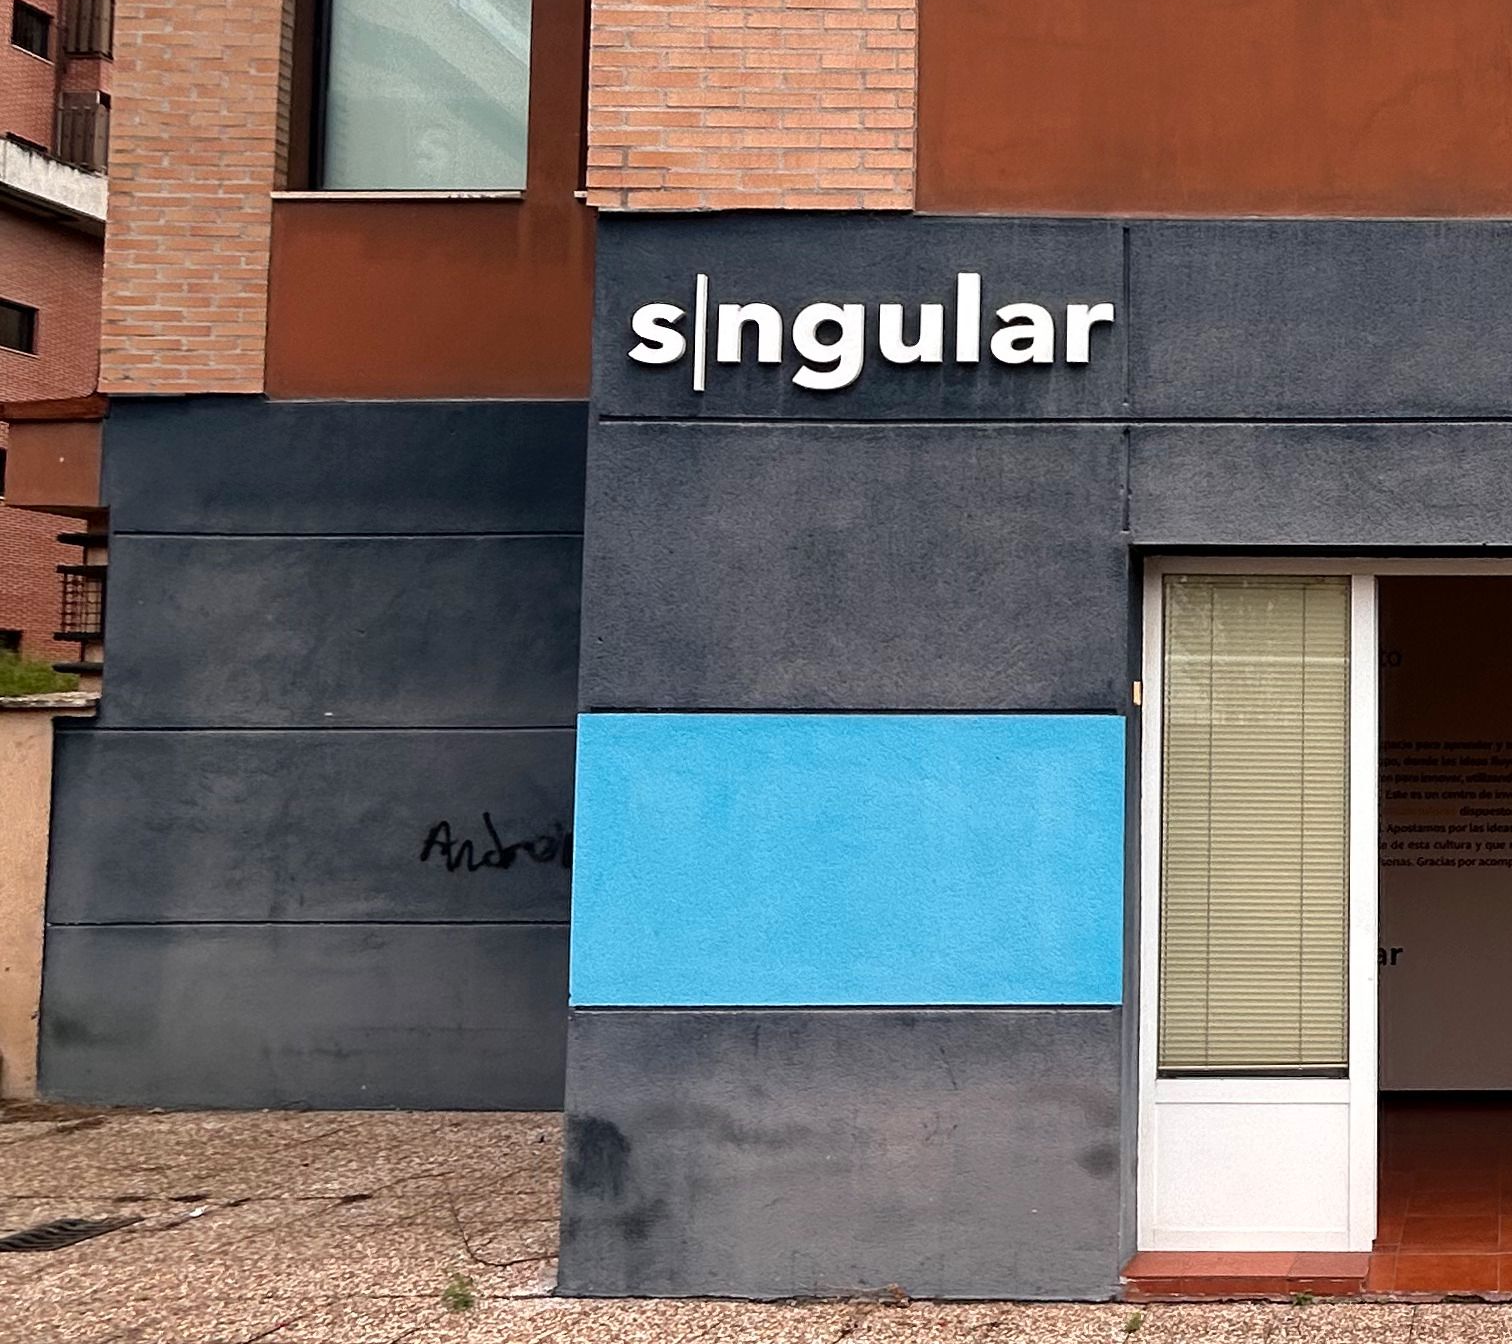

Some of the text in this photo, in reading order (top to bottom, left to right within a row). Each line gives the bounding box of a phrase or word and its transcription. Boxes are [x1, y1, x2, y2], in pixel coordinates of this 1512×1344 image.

[1441, 791, 1477, 799] centro
[1478, 789, 1493, 799] de
[1387, 824, 1446, 834] Apostamos
[1448, 826, 1468, 834] por
[1469, 823, 1484, 833] las
[1390, 840, 1404, 849] de
[1407, 841, 1430, 849] esta
[1433, 840, 1472, 849] cultura
[1474, 842, 1482, 851] y
[1485, 842, 1506, 851] que
[1416, 857, 1456, 866] Gracias
[1458, 859, 1477, 868] por
